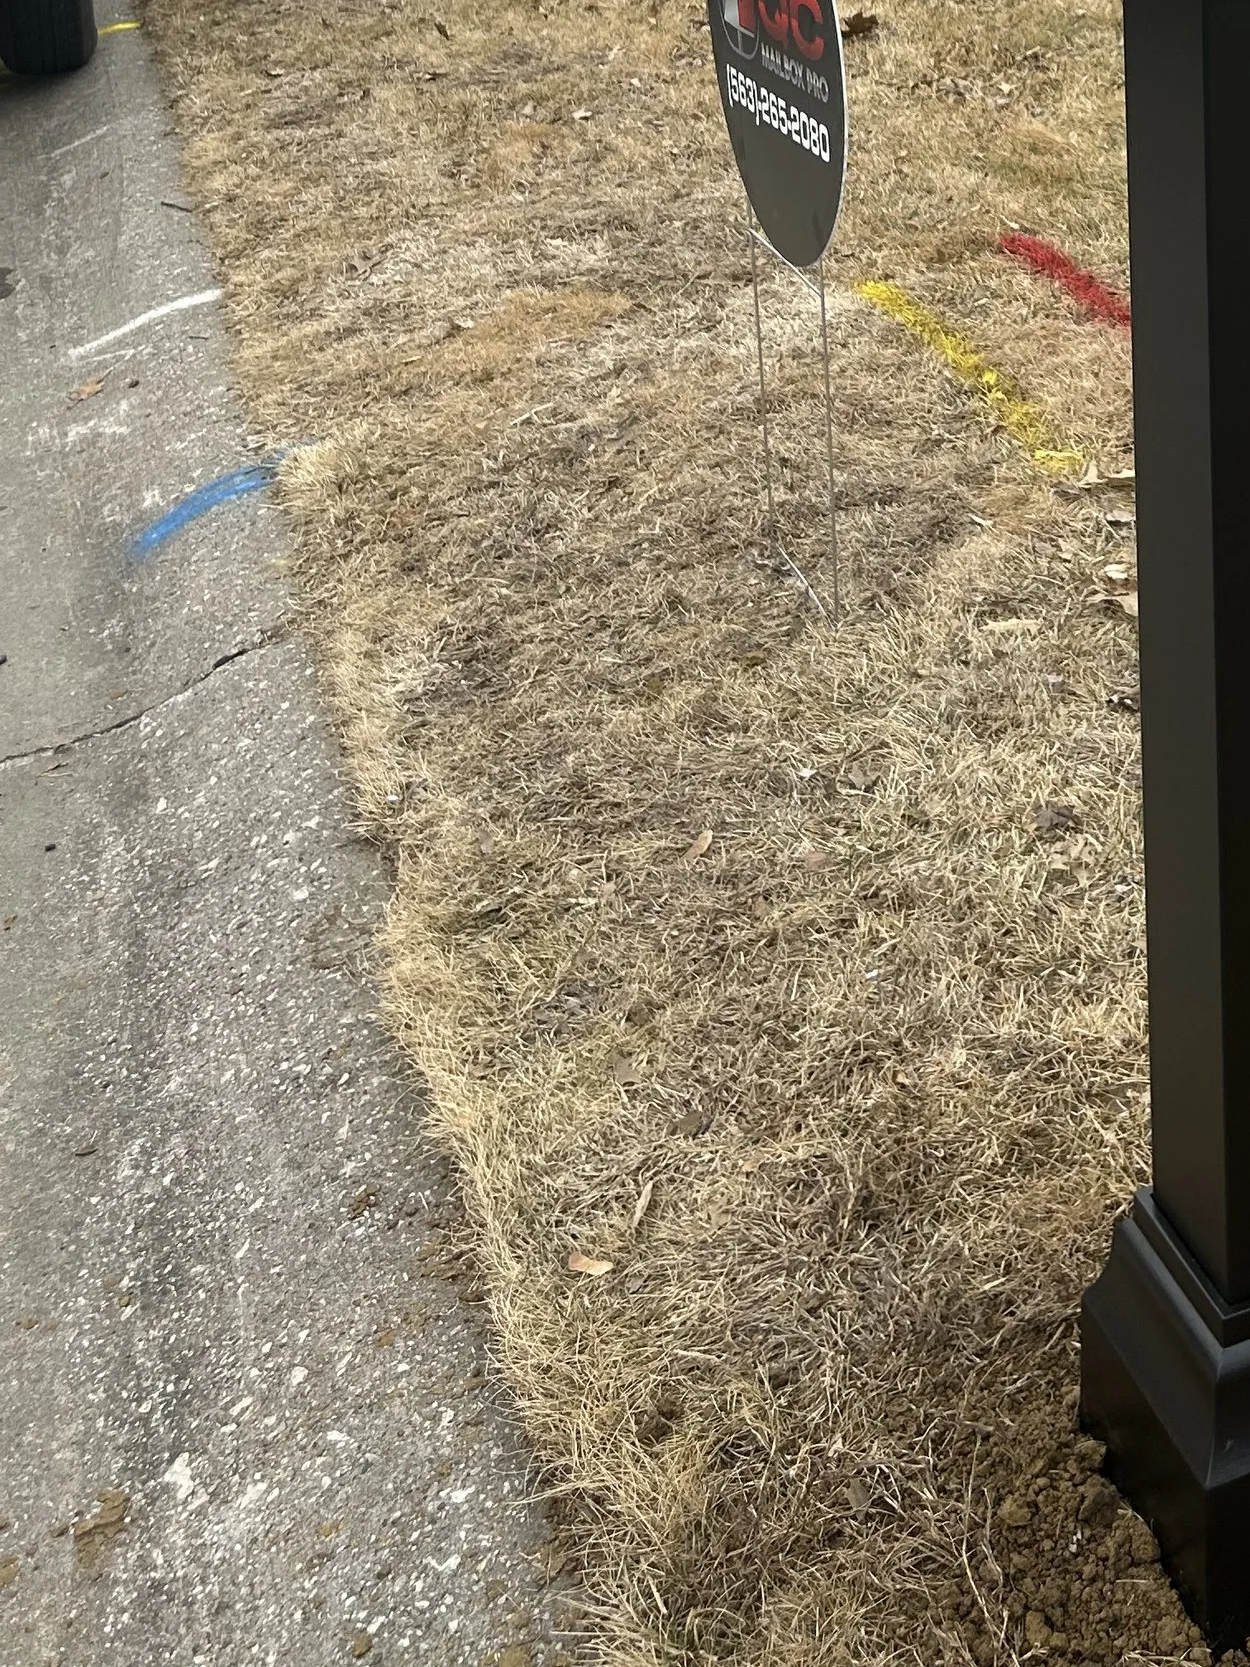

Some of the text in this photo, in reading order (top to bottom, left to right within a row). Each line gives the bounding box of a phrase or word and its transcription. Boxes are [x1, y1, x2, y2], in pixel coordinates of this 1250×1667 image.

[726, 63, 831, 164] (563)-265-2080
[761, 42, 830, 104] MAILBOX PRO
